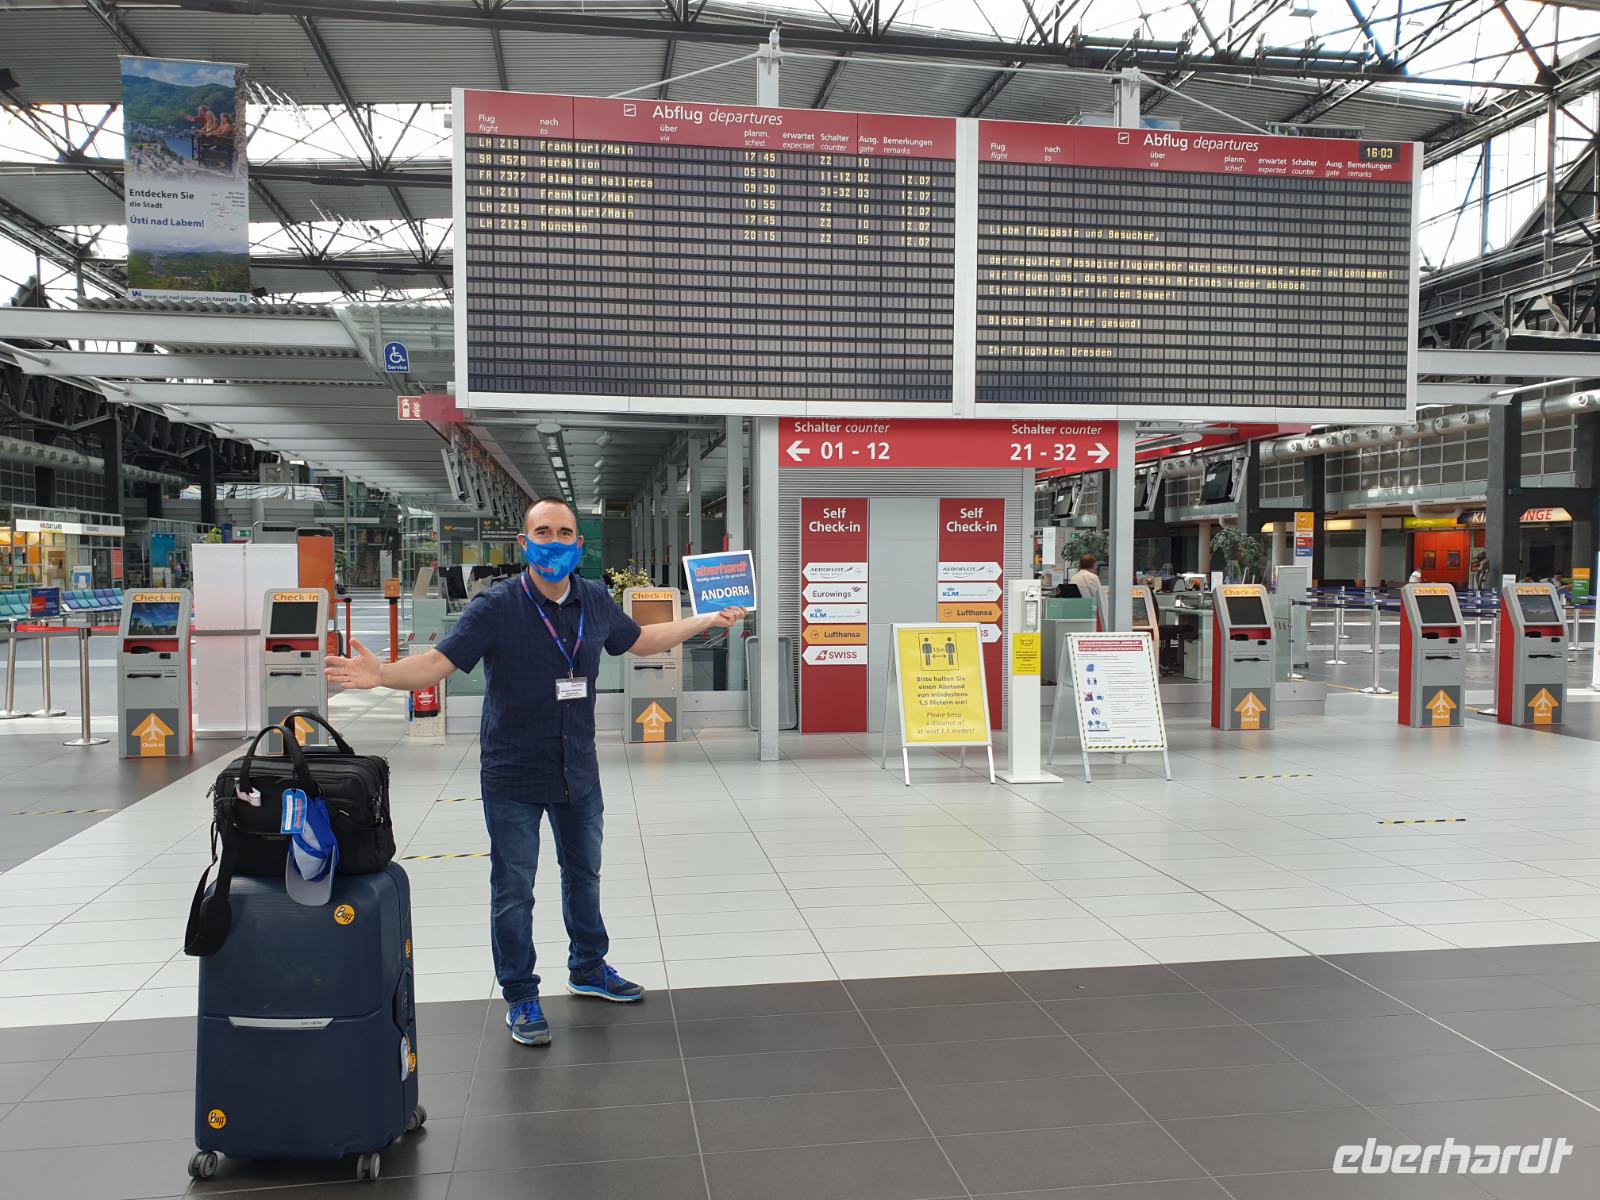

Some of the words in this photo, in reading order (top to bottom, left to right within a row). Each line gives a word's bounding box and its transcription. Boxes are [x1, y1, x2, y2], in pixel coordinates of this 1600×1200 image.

[479, 114, 495, 124] Flug
[653, 106, 703, 123] Abflug
[709, 110, 783, 125] departures
[540, 118, 558, 126] nach
[479, 125, 498, 133] flight
[660, 125, 677, 133] über
[744, 130, 769, 139] planm.
[783, 132, 815, 140] erwartet
[821, 134, 849, 142] Schalter
[783, 142, 814, 150] expected
[821, 143, 846, 151] counter
[884, 137, 932, 147] Bemerkungen
[991, 143, 1005, 151] Flug
[1144, 134, 1188, 150] Abflug
[1194, 137, 1259, 151] departures
[479, 139, 492, 148] LH
[500, 139, 519, 149] 219
[540, 141, 633, 154] Frankfurt/Main
[744, 153, 775, 161] 17:45
[858, 158, 869, 167] 10
[859, 146, 874, 154] gate
[1367, 147, 1393, 158] 16:03
[479, 154, 492, 164] SR
[500, 155, 526, 165] 4578
[540, 158, 600, 169] Heraklion
[744, 168, 775, 177] 05:30
[821, 172, 850, 181] 11-12
[858, 174, 869, 182] 02
[1292, 159, 1317, 167] Schalter
[1348, 162, 1392, 170] Bemerkungen
[479, 170, 492, 179] FR
[500, 171, 526, 180] 7377
[540, 174, 573, 184] Palma
[581, 176, 593, 185] de
[601, 177, 653, 187] Mallorca
[744, 184, 775, 193] 09:30
[820, 188, 850, 197] 31-32
[858, 189, 869, 198] 03
[129, 189, 178, 198] Entdecken
[479, 186, 492, 196] LH
[500, 187, 519, 197] 211
[541, 189, 633, 202] Frankfurt/Main
[744, 200, 775, 209] 10:55
[820, 203, 831, 211] 22
[858, 205, 869, 213] 10
[479, 202, 492, 212] LH
[500, 203, 519, 213] 219
[541, 205, 633, 218] Frankfurt/Main
[744, 216, 775, 224] 17:45
[820, 219, 831, 227] 22
[858, 220, 869, 229] 10
[130, 215, 148, 224] Ústí
[171, 219, 204, 227] Labem!
[480, 219, 493, 228] LH
[501, 220, 527, 229] 2129
[541, 220, 587, 232] München
[744, 231, 775, 240] 20:15
[820, 234, 831, 243] 22
[858, 236, 868, 244] 05
[990, 225, 1019, 234] Liebe
[1027, 226, 1079, 237] Fluggäste
[1086, 230, 1102, 238] und
[1109, 231, 1159, 241] Besucher,
[990, 256, 1007, 265] der
[1014, 257, 1060, 267] reguläre
[1067, 259, 1182, 271] Passagierflugverkehr
[1189, 263, 1210, 273] wird
[1217, 264, 1283, 274] schrittweise
[1289, 268, 1321, 276] wieder
[990, 271, 1007, 279] Wir
[1014, 272, 1049, 281] freuen
[1055, 273, 1077, 282] uns,
[1085, 274, 1107, 283] dass
[1114, 276, 1130, 284] die
[1137, 277, 1170, 285] ersten
[1177, 277, 1221, 287] Airlines
[1228, 280, 1260, 288] wieder
[1267, 281, 1309, 290] abheben.
[989, 285, 1018, 295] Einen
[1025, 287, 1054, 297] guten
[1061, 288, 1089, 297] Start
[1114, 290, 1130, 298] den
[1137, 290, 1175, 300] Sommer!
[989, 316, 1030, 326] Bleiben
[1037, 317, 1054, 326] Sie
[1061, 318, 1095, 327] weiter
[1102, 320, 1140, 329] gesund!
[989, 346, 1005, 354] Ihr
[1013, 347, 1064, 356] Flughafen
[1072, 348, 1112, 357] Dresden
[795, 422, 840, 433] Schalter
[845, 423, 890, 433] counter
[1012, 424, 1056, 434] Schalter
[1060, 426, 1102, 434] counter
[821, 442, 843, 459] 01
[867, 442, 890, 460] 12
[1010, 444, 1032, 460] 21
[1054, 444, 1076, 460] 32
[824, 508, 846, 518] Self
[960, 508, 983, 518] Self
[809, 522, 860, 532] Check-in
[947, 522, 997, 532] Check-in
[702, 585, 749, 600] ANDORRA
[813, 591, 851, 601] Eurowings
[133, 594, 180, 602] Check-in
